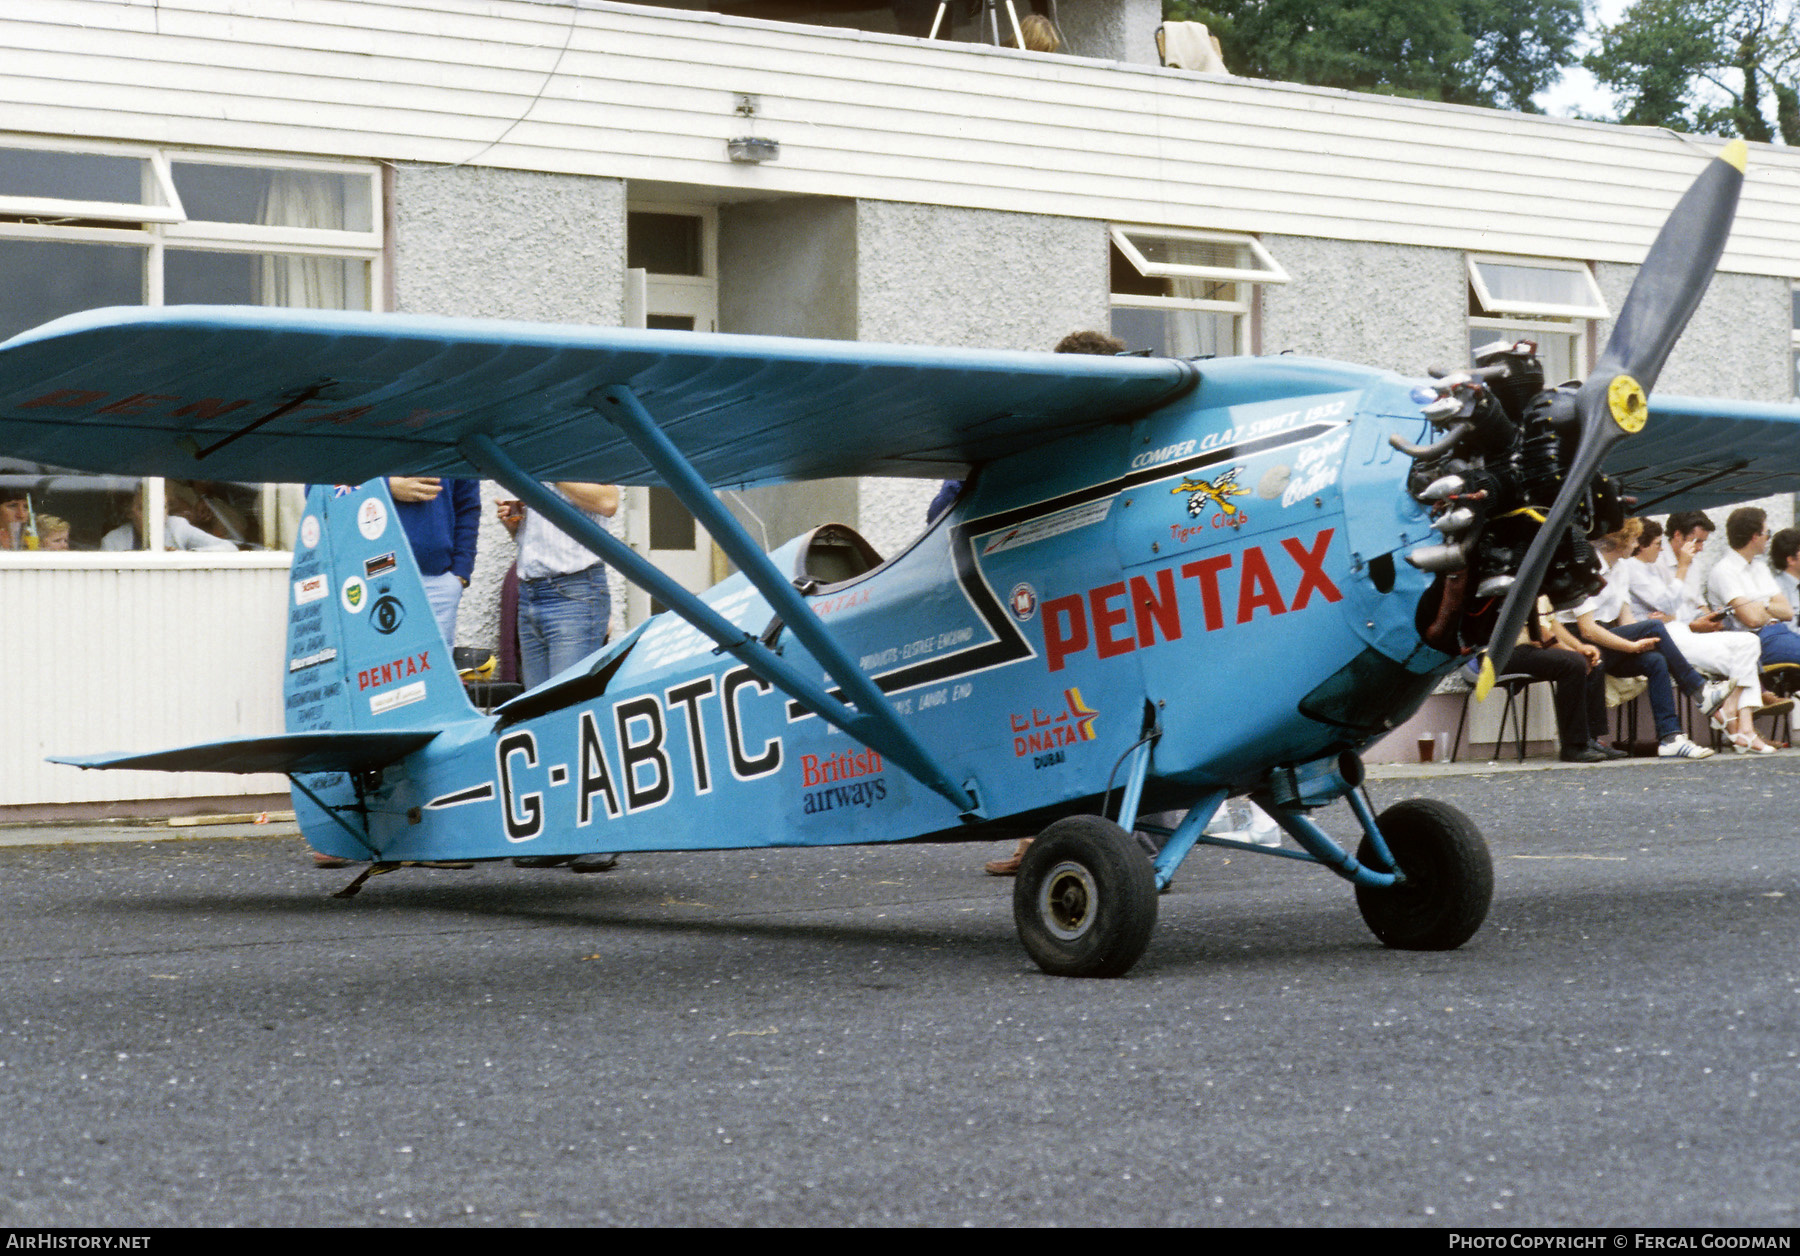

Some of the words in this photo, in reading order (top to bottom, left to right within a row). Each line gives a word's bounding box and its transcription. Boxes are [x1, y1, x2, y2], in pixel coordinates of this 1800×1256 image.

[1131, 438, 1198, 469] COMPER
[1249, 410, 1300, 438] SWIFT
[1304, 400, 1346, 422] 1932
[1169, 523, 1204, 544] Tiger
[1210, 510, 1249, 530] Club
[812, 587, 875, 618] ENTAX
[1040, 527, 1344, 673] PENTAX
[358, 650, 431, 692] PENTAX
[495, 663, 785, 844] G-ABTC
[1014, 724, 1078, 758] DNATA
[1033, 750, 1067, 770] DUBAI
[800, 747, 884, 788] British
[803, 778, 887, 815] airways
